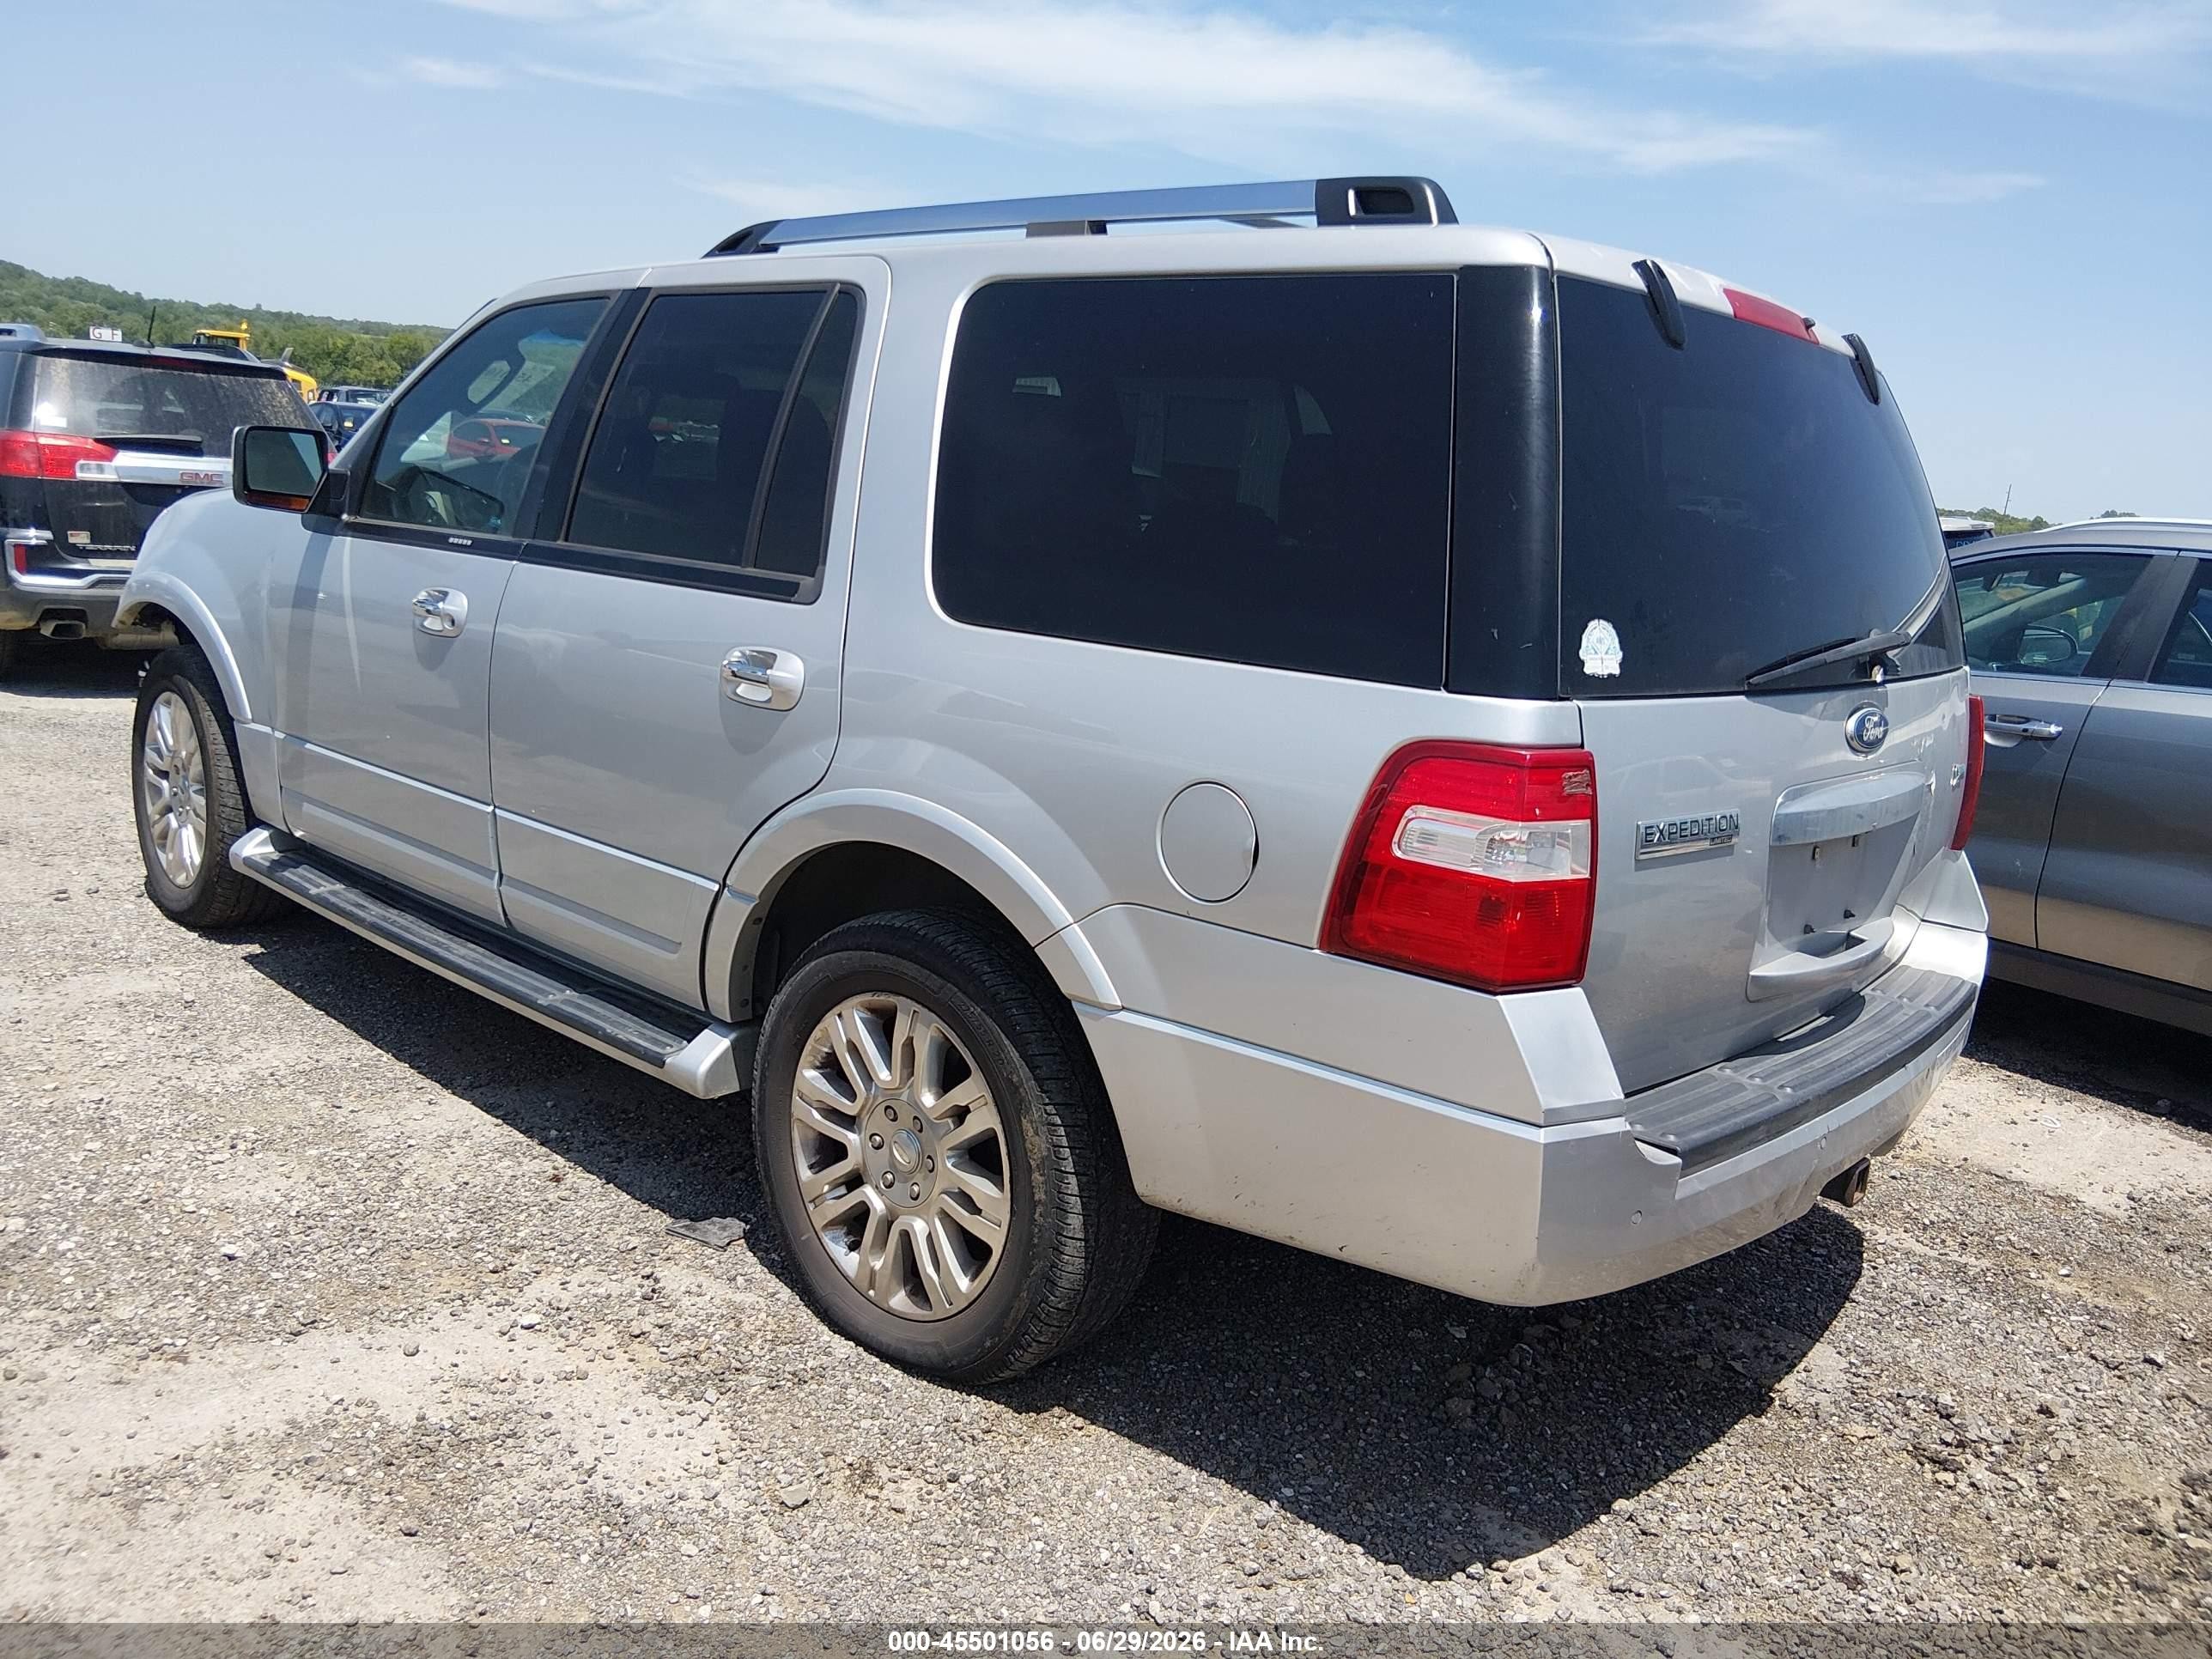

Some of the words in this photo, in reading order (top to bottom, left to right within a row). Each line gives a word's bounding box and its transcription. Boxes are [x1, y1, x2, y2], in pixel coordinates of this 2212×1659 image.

[179, 471, 224, 484] GMC
[1863, 714, 1887, 742] Ford
[1644, 812, 1740, 843] EXPEDITION
